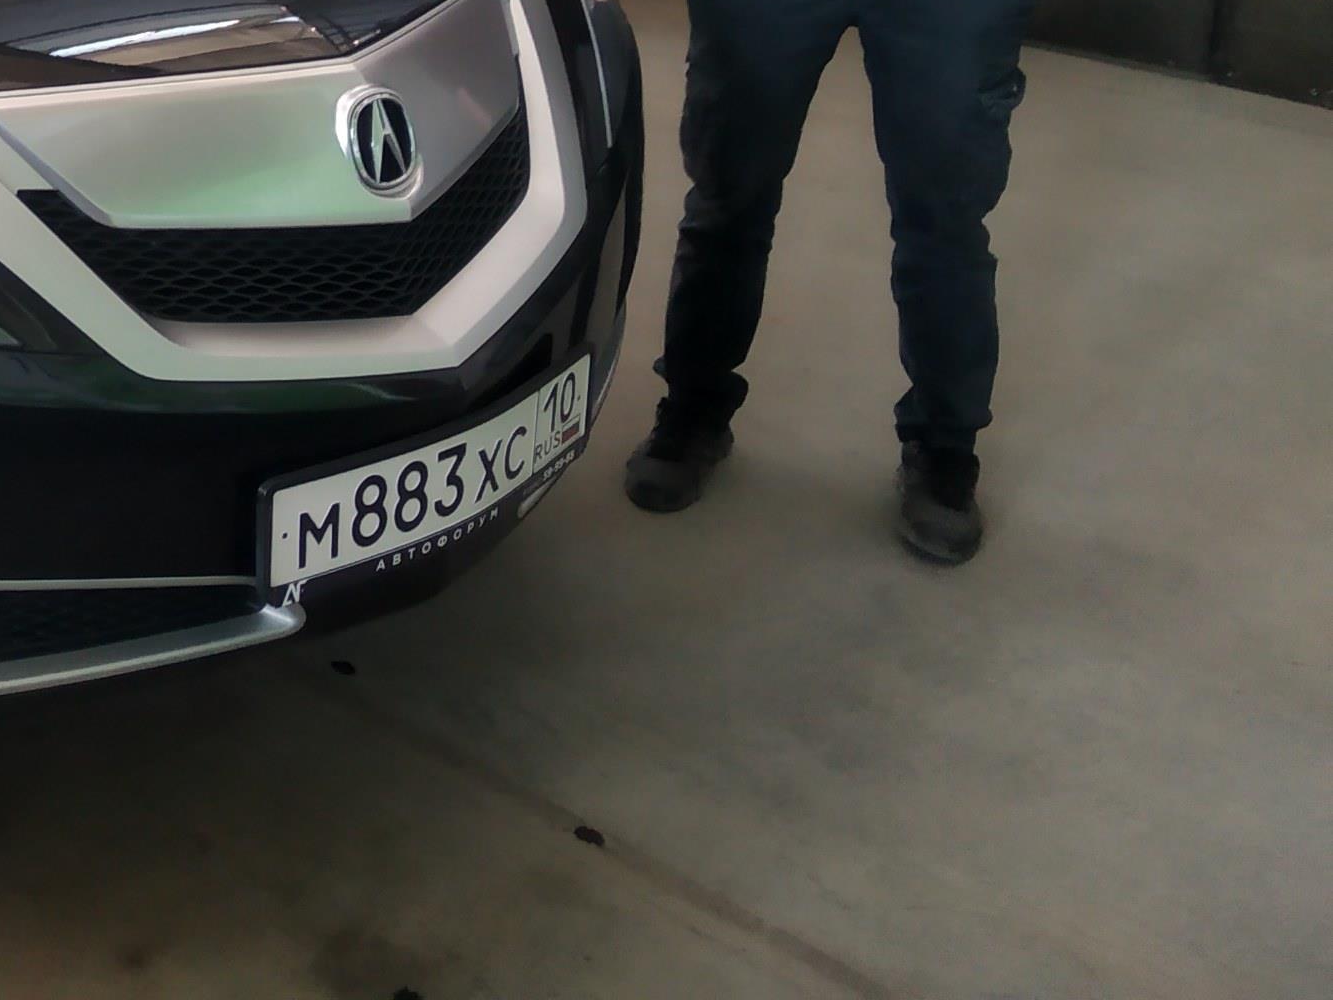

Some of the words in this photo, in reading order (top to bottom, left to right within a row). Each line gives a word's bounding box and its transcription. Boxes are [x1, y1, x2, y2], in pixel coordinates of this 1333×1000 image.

[543, 371, 576, 433] 10
[534, 430, 561, 460] RUS
[298, 425, 527, 570] М883ХС
[375, 507, 499, 573] АВТОФОРУМ
